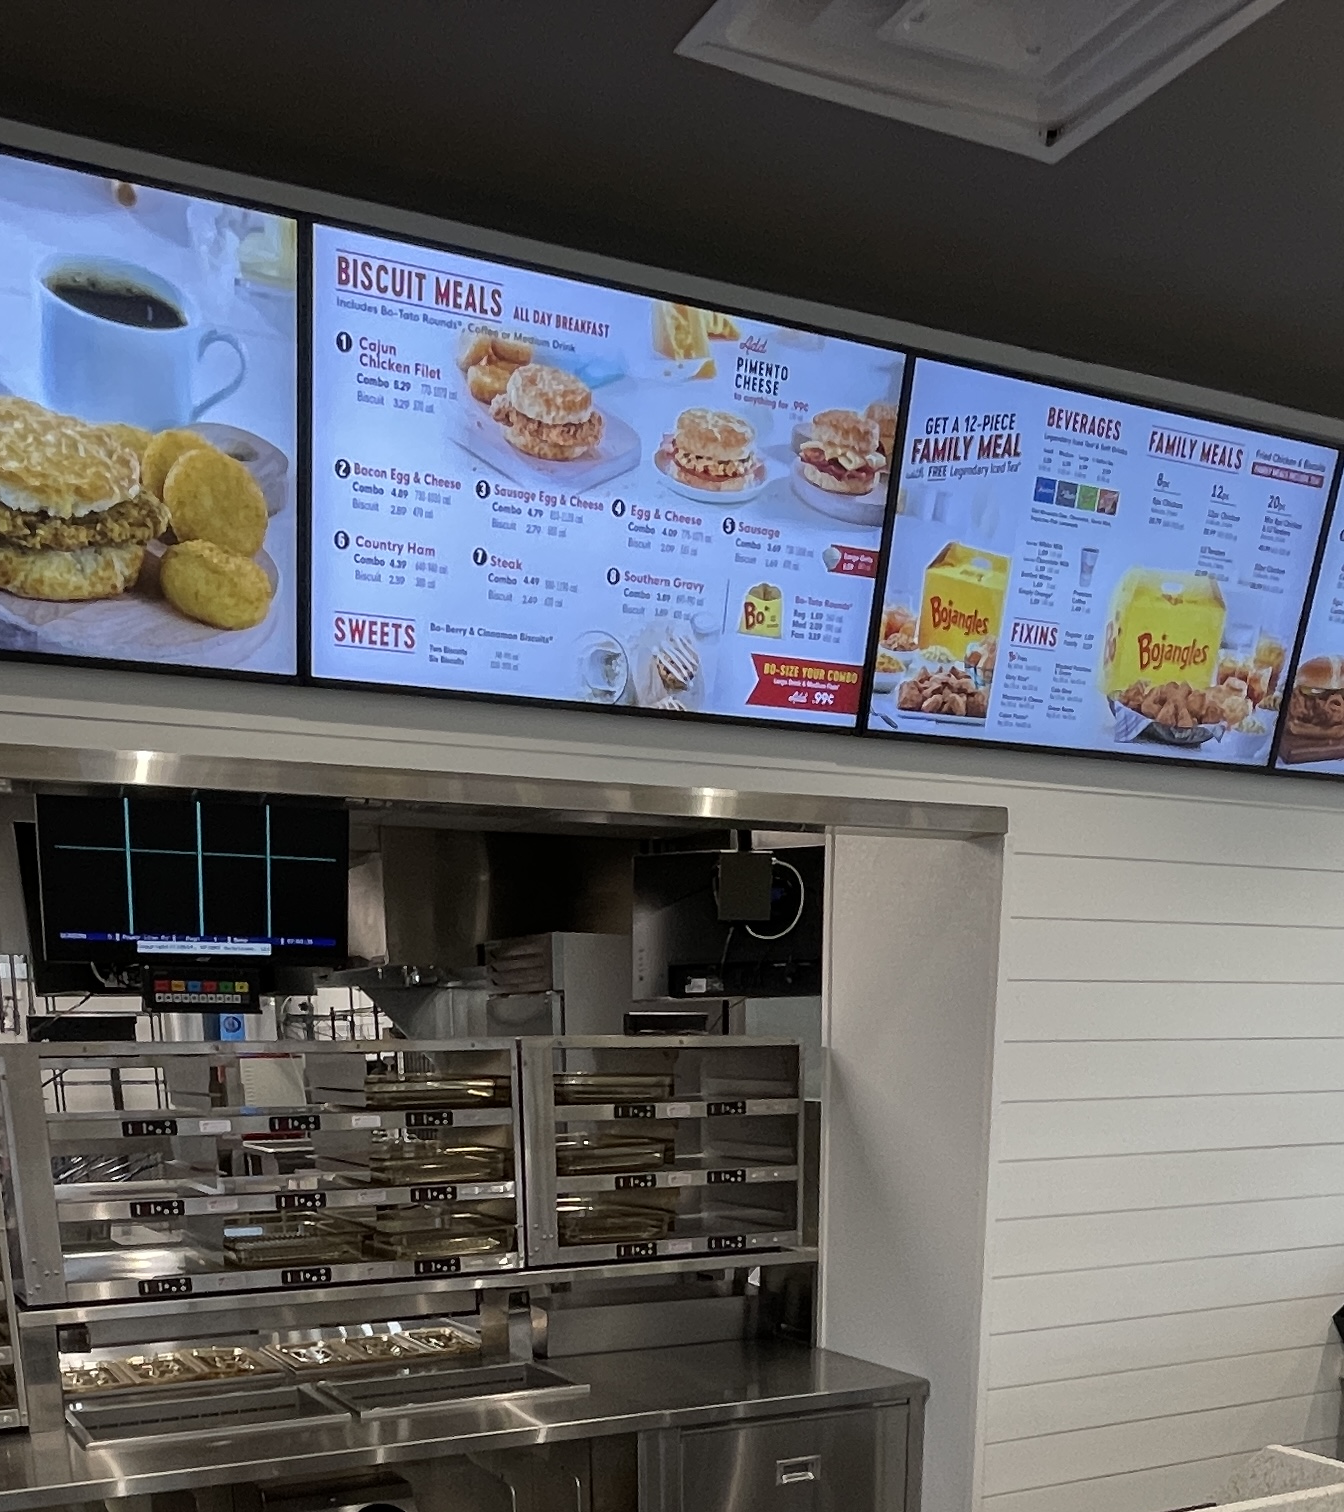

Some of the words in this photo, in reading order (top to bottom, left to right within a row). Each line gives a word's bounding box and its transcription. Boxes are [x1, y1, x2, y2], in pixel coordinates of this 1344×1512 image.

[337, 256, 426, 301] BISCUIT
[435, 276, 502, 317] MEALS
[336, 296, 378, 315] Includes
[381, 305, 420, 322] Bo-Tato
[467, 322, 499, 338] Coffee
[501, 332, 511, 340] or
[514, 332, 550, 348] Medium
[552, 339, 575, 352] Drink
[513, 306, 530, 323] ALL
[533, 310, 553, 327] DAY
[556, 314, 610, 338] BREAKFAST
[359, 337, 397, 356] Cajun
[739, 335, 768, 355] Add
[359, 353, 411, 374] Chicken
[414, 363, 441, 380] Filet
[736, 357, 788, 380] PIMENTO
[357, 373, 390, 388] Combo
[735, 373, 779, 396] CHEESE
[357, 391, 385, 405] Biscuit
[393, 398, 410, 410] 3.29
[925, 416, 949, 435] GET
[951, 416, 960, 434] A
[964, 413, 1016, 433] 12-PIECE
[1047, 406, 1122, 441] BEVERAGES
[911, 435, 974, 464] FAMILY
[977, 433, 1022, 460] MEAL
[1148, 431, 1197, 459] FAMILY
[1200, 441, 1244, 470] MEALS
[354, 463, 387, 479] Bacon
[390, 468, 410, 485] Egg
[413, 472, 421, 484] &
[424, 473, 462, 490] Cheese
[927, 465, 947, 478] FREE
[950, 465, 989, 480] Legendary
[990, 462, 1006, 474] Iced
[352, 481, 384, 495] Combo
[494, 484, 536, 503] Sausage
[539, 491, 557, 507] Egg
[560, 494, 567, 506] &
[570, 495, 604, 511] Cheese
[352, 498, 379, 512] Biscuit
[492, 502, 522, 515] Combo
[527, 508, 544, 518] 4.79
[631, 504, 651, 521] Egg
[654, 508, 661, 520] &
[664, 510, 702, 526] Cheese
[492, 518, 517, 531] Biscuit
[526, 524, 542, 534] 2.79
[627, 521, 656, 535] Combo
[738, 521, 780, 539] Sausage
[355, 535, 404, 555] Country
[407, 542, 435, 557] Ham
[628, 537, 651, 549] Biscuit
[735, 537, 761, 550] Combo
[353, 553, 385, 567] Combo
[490, 555, 522, 570] Steak
[355, 570, 382, 582] Biscuit
[488, 573, 517, 586] Combo
[624, 570, 671, 587] Southern
[673, 578, 704, 594] Gravy
[623, 588, 651, 600] Combo
[930, 596, 989, 635] Bojangles
[334, 616, 415, 649] SWEETS
[430, 623, 467, 636] Bo-Berry
[468, 627, 475, 636] &
[477, 628, 518, 640] Cinnamon
[1010, 622, 1058, 647] FIXINS
[1138, 632, 1209, 670] Bojangles
[764, 663, 799, 678] BO-SIZE
[802, 667, 825, 680] YOUR
[827, 670, 858, 684] COMBO
